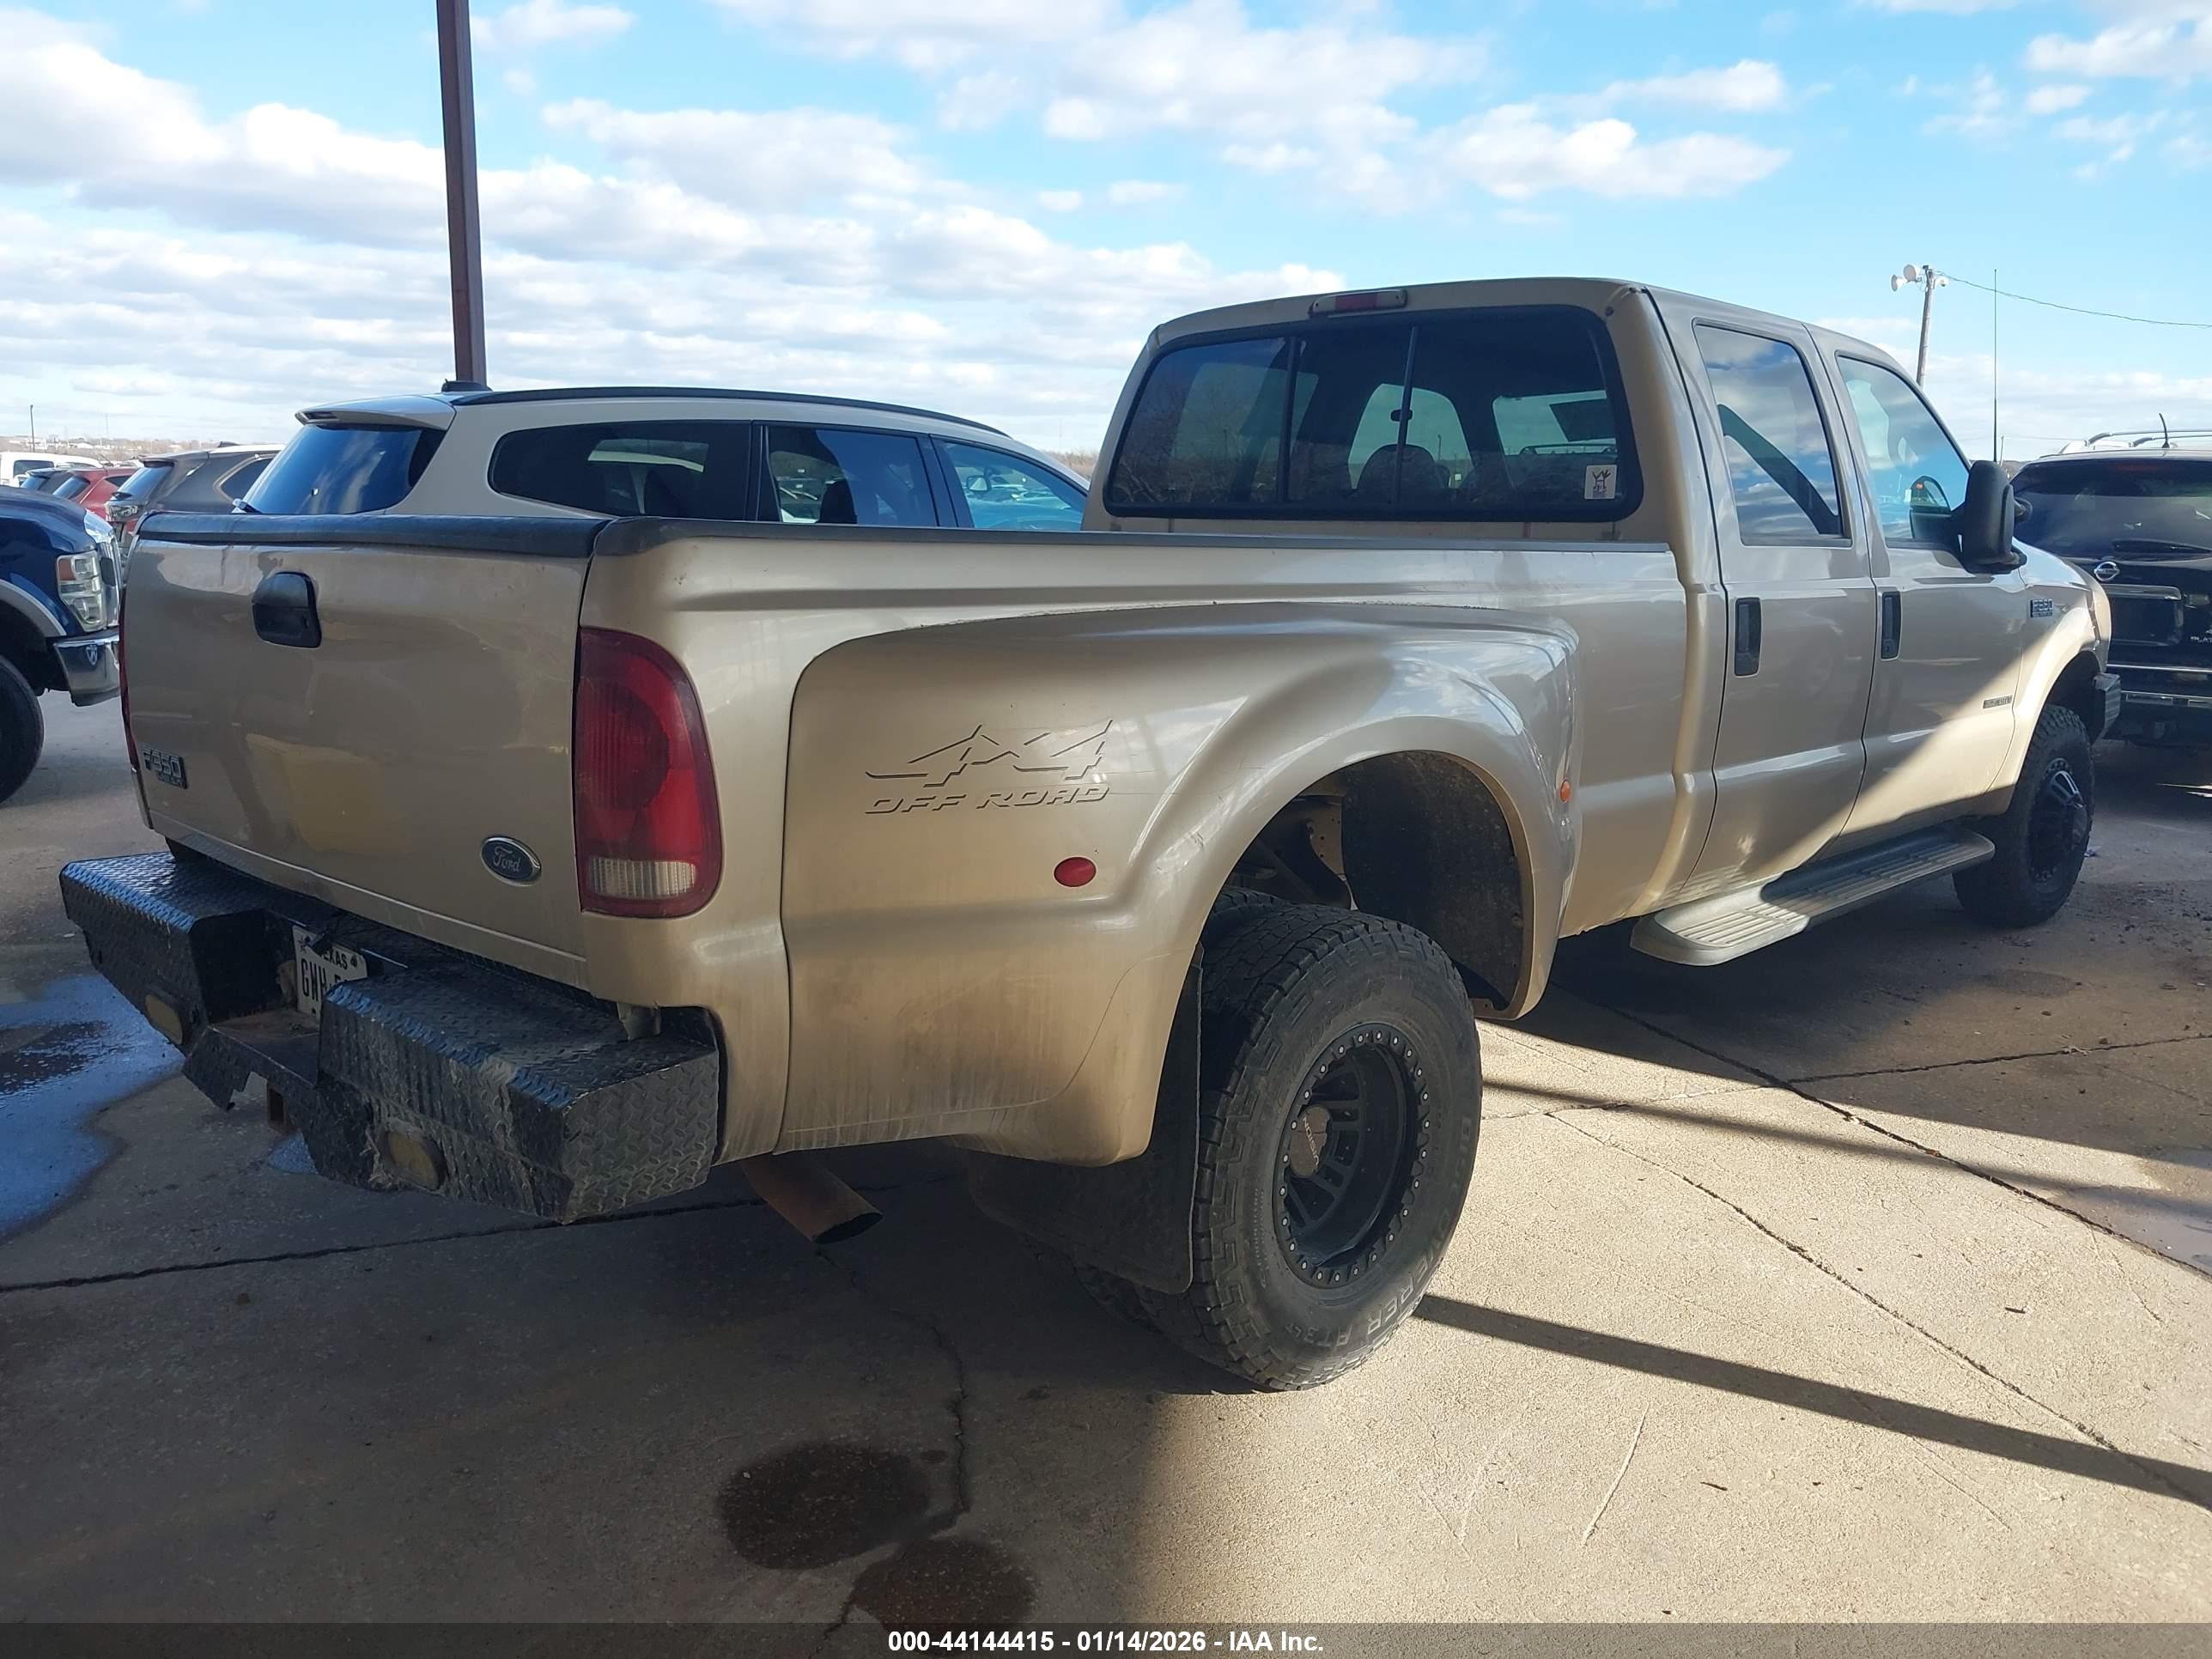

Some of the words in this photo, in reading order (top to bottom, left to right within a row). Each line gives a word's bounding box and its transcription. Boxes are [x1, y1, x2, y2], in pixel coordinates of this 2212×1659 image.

[865, 793, 967, 815] OFF
[975, 787, 1109, 810] ROAD
[493, 845, 522, 872] Ford
